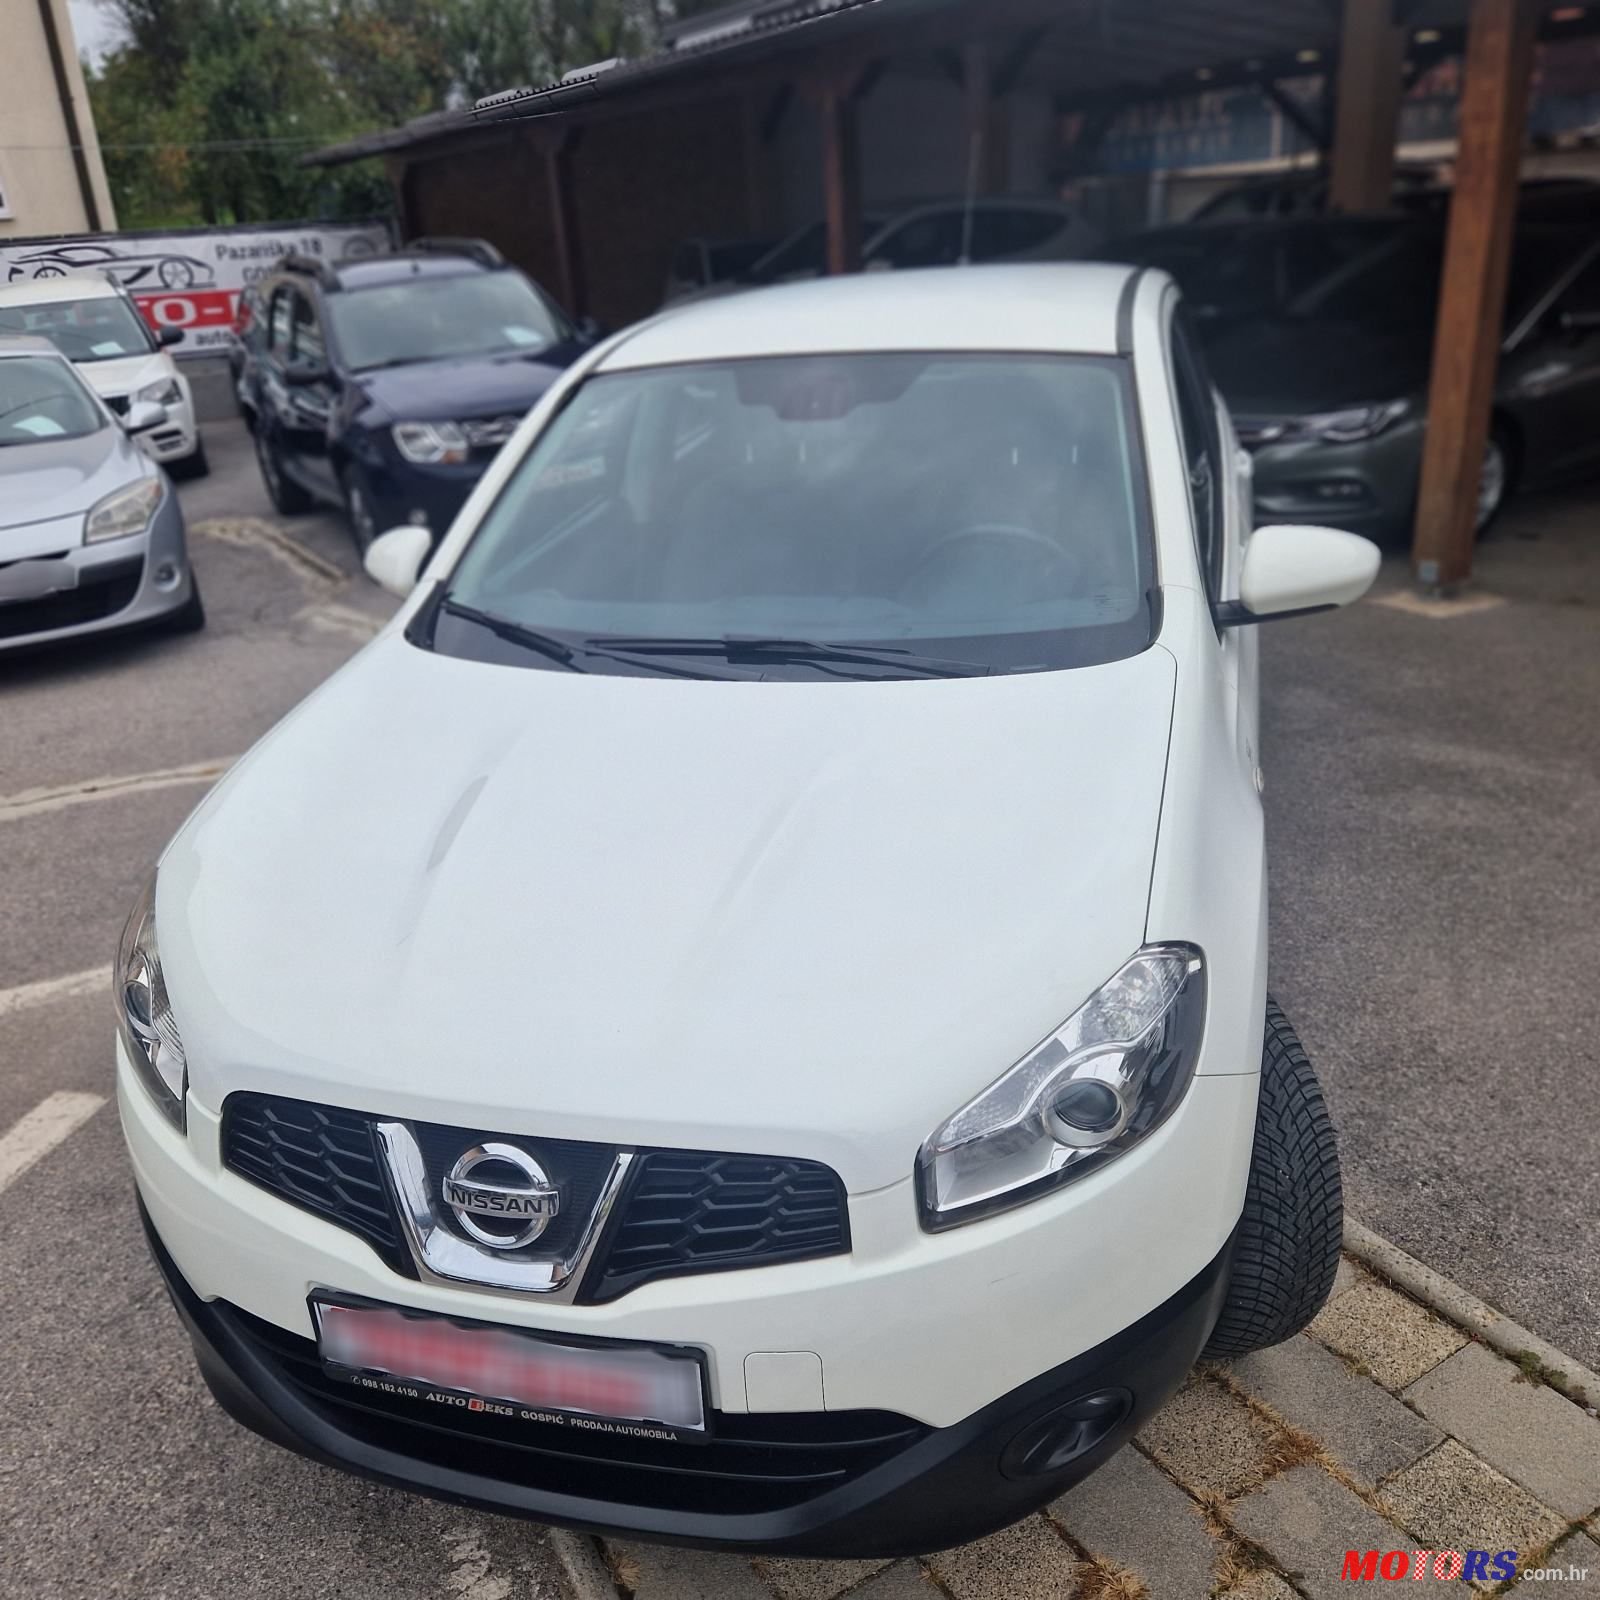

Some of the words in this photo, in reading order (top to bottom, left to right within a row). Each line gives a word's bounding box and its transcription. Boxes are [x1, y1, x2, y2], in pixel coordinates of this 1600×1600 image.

[299, 237, 323, 255] 18
[451, 1189, 542, 1214] NISSAN
[397, 1386, 418, 1398] 4150
[425, 1392, 466, 1407] AUTO
[521, 1410, 565, 1425] GOSPIĆ
[570, 1418, 615, 1433] PRODAJA
[616, 1425, 678, 1441] AUTOMOBILA
